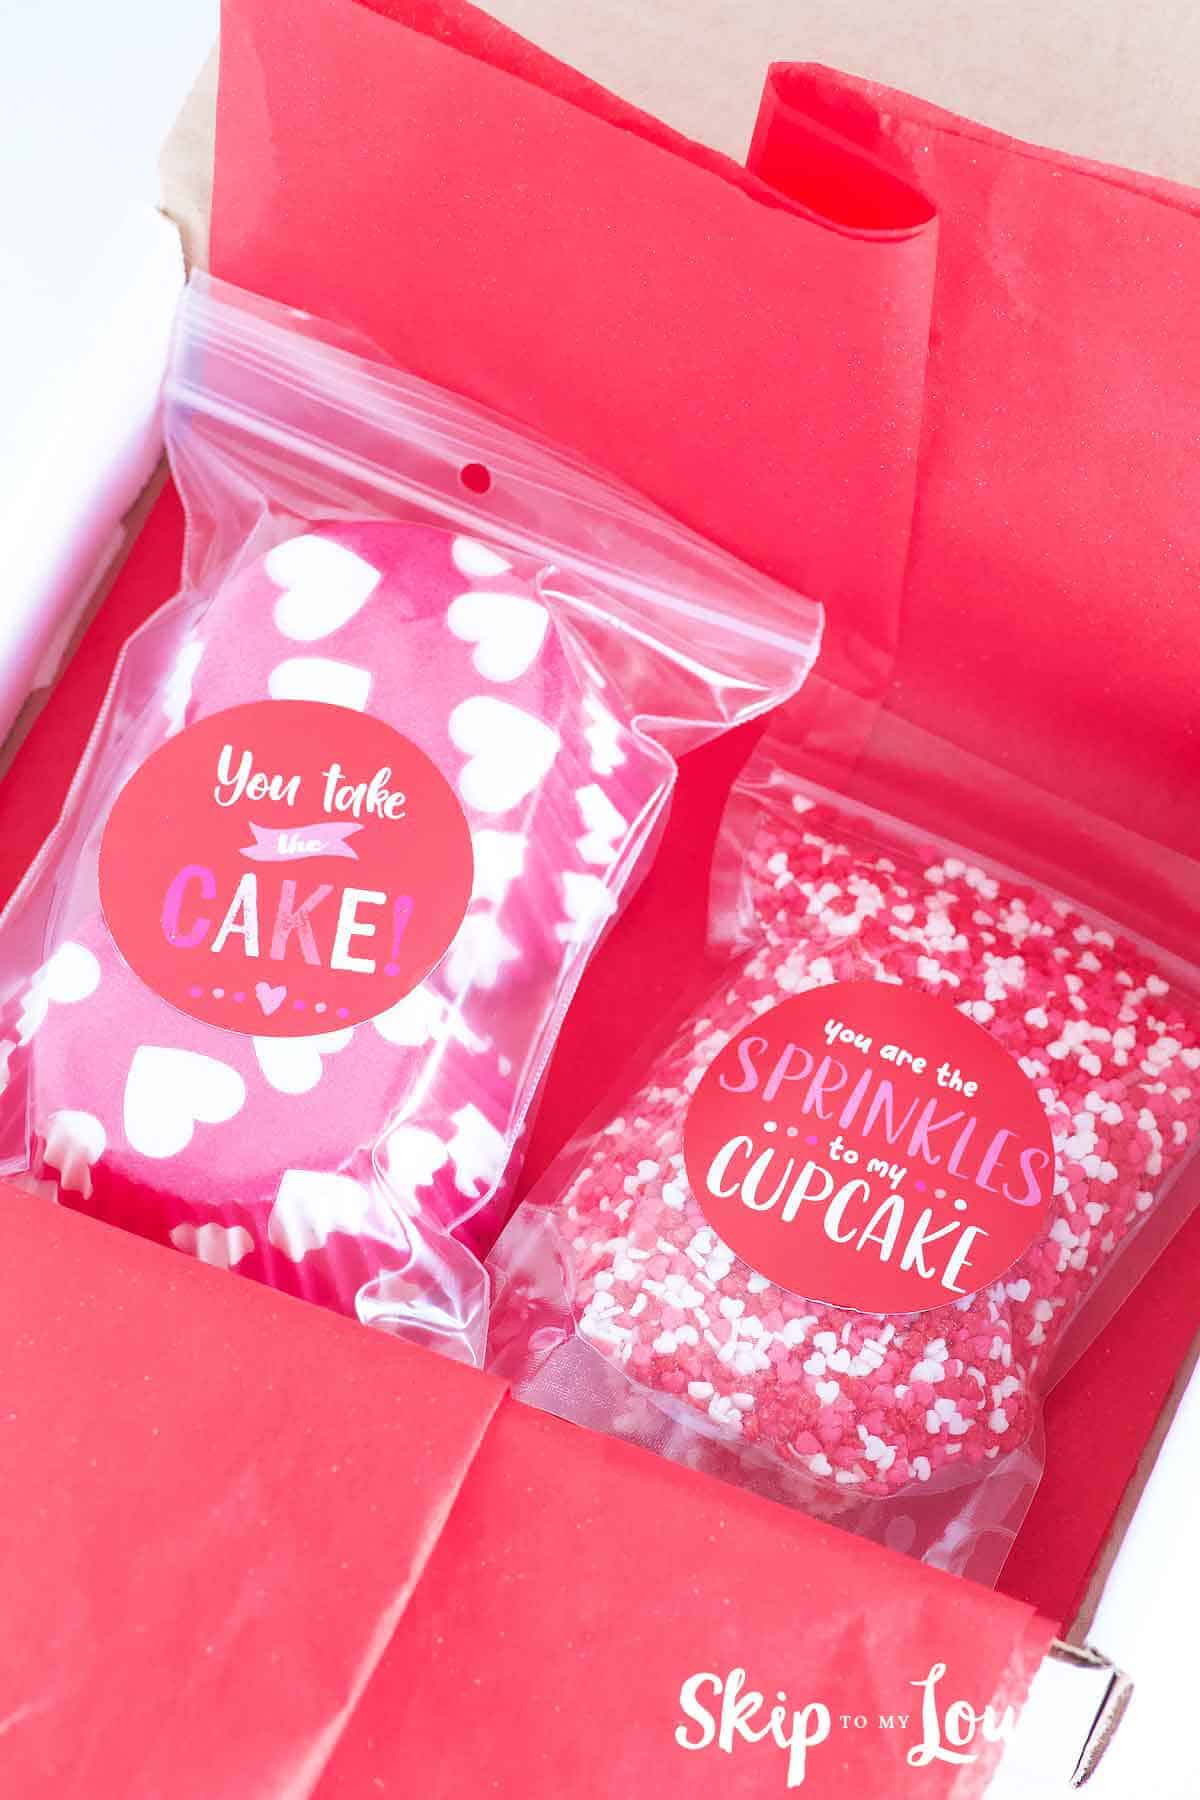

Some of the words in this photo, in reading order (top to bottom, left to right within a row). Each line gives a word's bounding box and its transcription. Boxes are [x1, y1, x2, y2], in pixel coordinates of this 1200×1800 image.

[213, 744, 301, 806] You
[322, 763, 406, 820] take
[276, 833, 327, 855] the
[161, 864, 414, 976] CAKE!
[824, 1019, 872, 1054] you
[880, 1044, 928, 1073] are
[936, 1063, 979, 1097] the
[719, 1036, 1049, 1206] SPRINKLES
[829, 1136, 859, 1164] to
[866, 1157, 908, 1190] my
[706, 1135, 990, 1294] CUPCAKE
